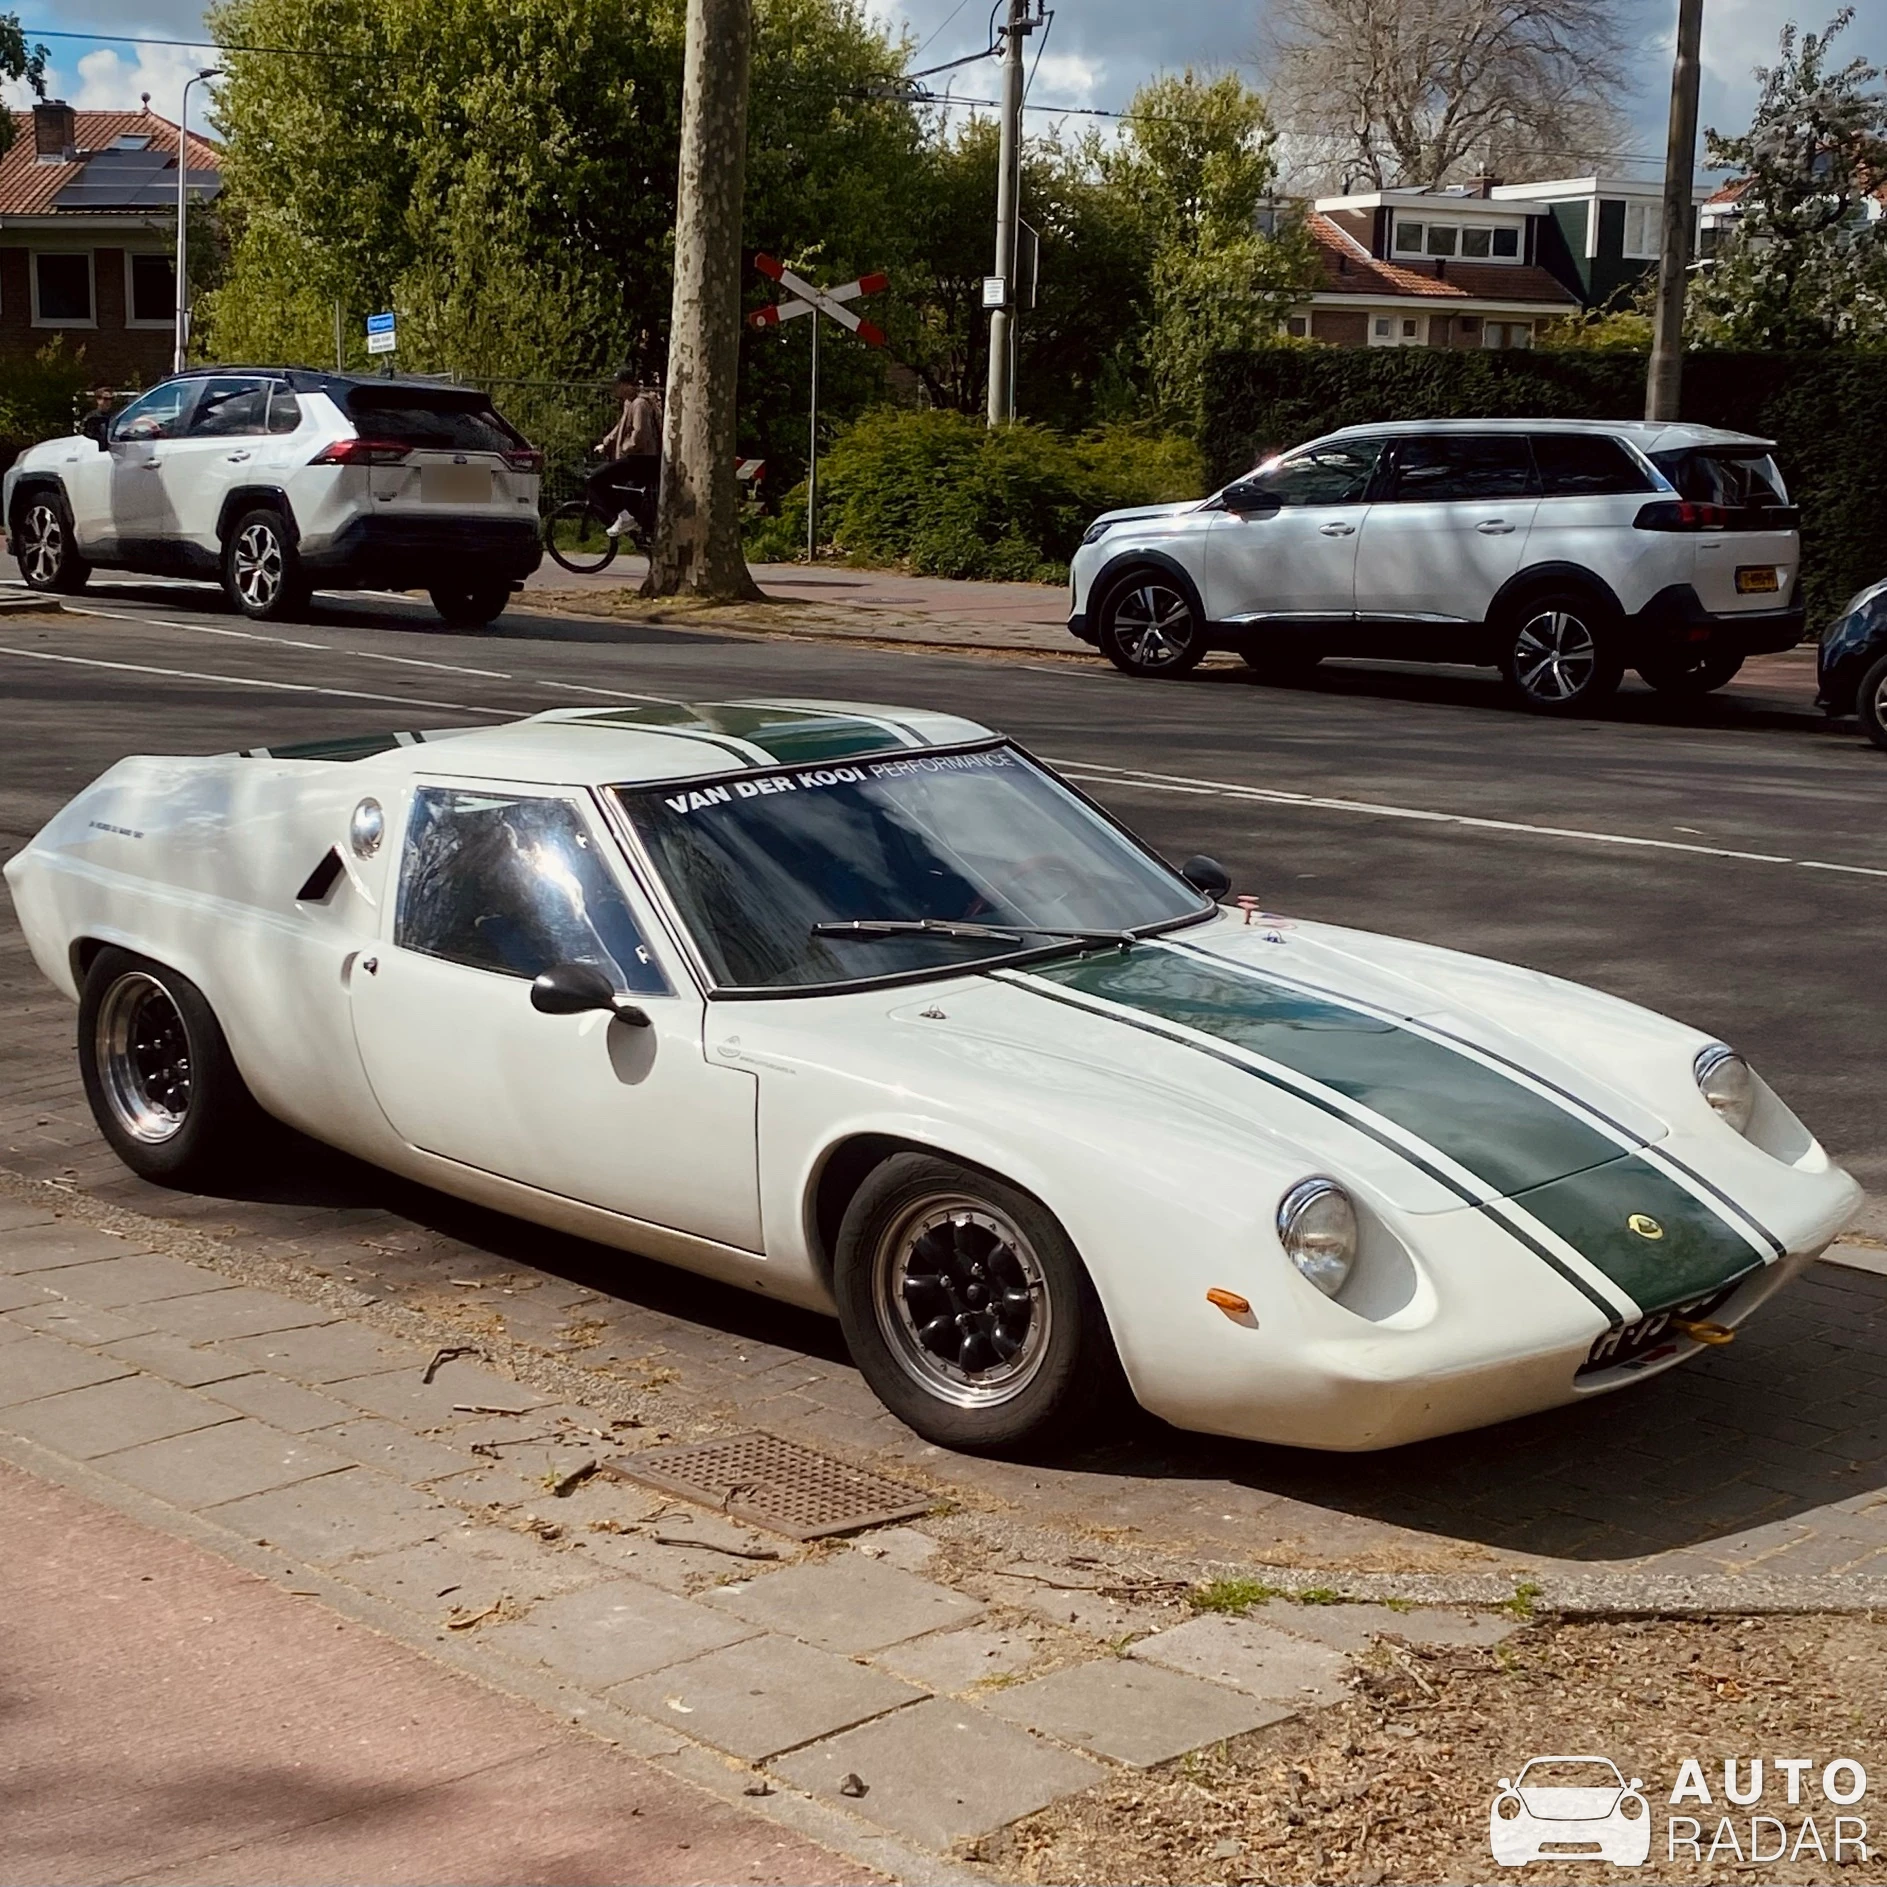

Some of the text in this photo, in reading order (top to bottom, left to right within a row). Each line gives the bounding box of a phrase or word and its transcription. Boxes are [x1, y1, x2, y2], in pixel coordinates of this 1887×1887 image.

[665, 752, 1016, 814] VAN DER KOOI PERFORMANCE
